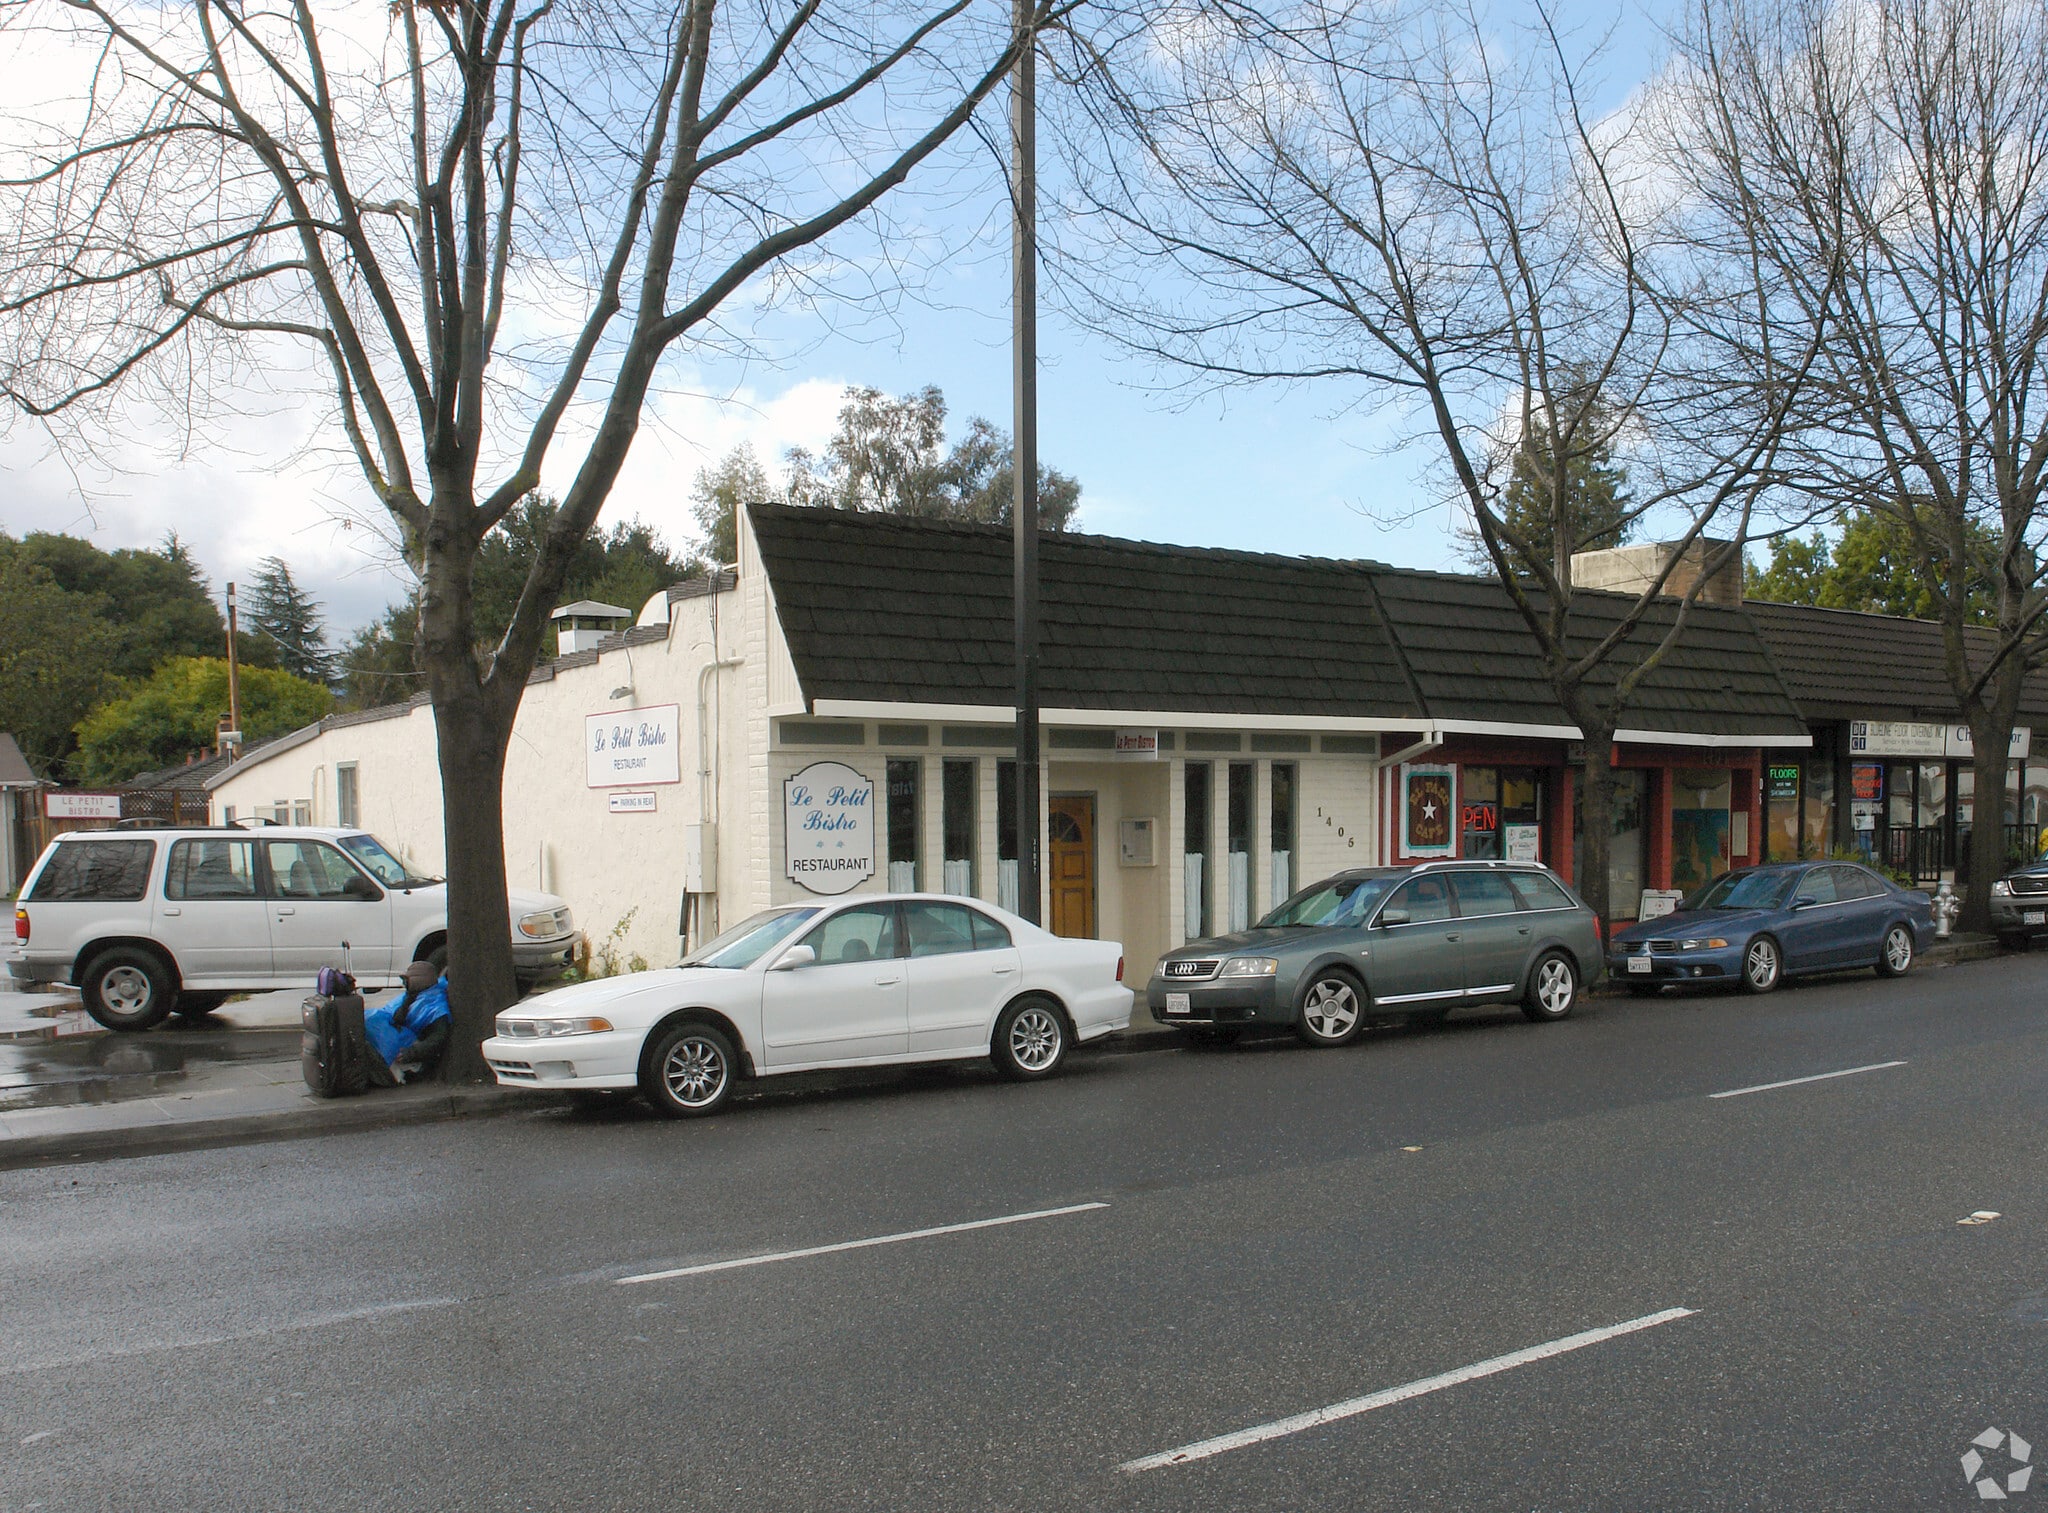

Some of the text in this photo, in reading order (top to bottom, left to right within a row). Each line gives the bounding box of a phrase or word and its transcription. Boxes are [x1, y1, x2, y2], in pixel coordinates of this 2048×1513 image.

[594, 722, 666, 752] Le Petit Bistro
[614, 758, 647, 770] RESTAURANT
[1770, 769, 1797, 778] FLOORS
[63, 797, 104, 805] LE PETIT
[790, 786, 813, 806] Le
[826, 786, 869, 806] Petit
[68, 808, 101, 816] BISTRO
[1462, 806, 1497, 831] PEN
[803, 810, 857, 831] Bistro
[793, 857, 869, 872] RESTAURANT
